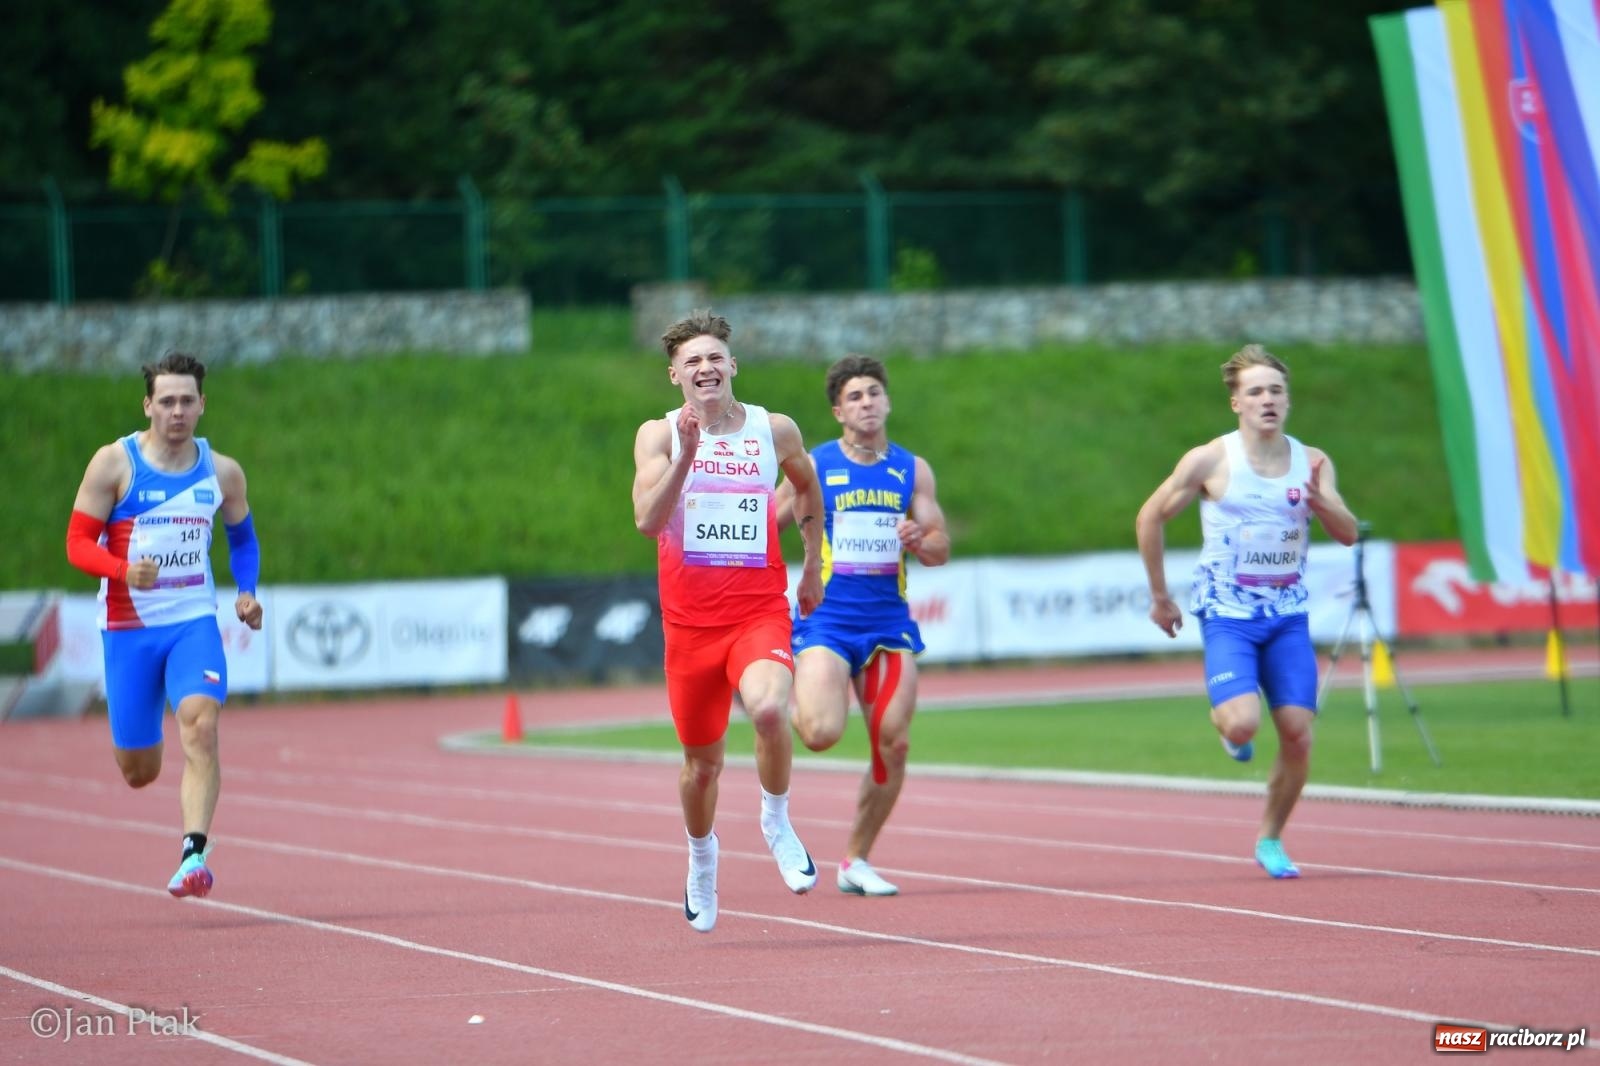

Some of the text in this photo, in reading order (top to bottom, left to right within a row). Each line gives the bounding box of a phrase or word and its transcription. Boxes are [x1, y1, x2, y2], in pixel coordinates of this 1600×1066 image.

[692, 460, 760, 475] POLSKA
[738, 498, 759, 512] 43
[835, 489, 902, 512] UKRAINE
[138, 516, 170, 525] CZECH
[874, 516, 898, 528] 443
[180, 528, 201, 543] 143
[696, 523, 757, 541] SARLEJ
[1280, 529, 1299, 542] 348
[1243, 550, 1297, 565] JANURA
